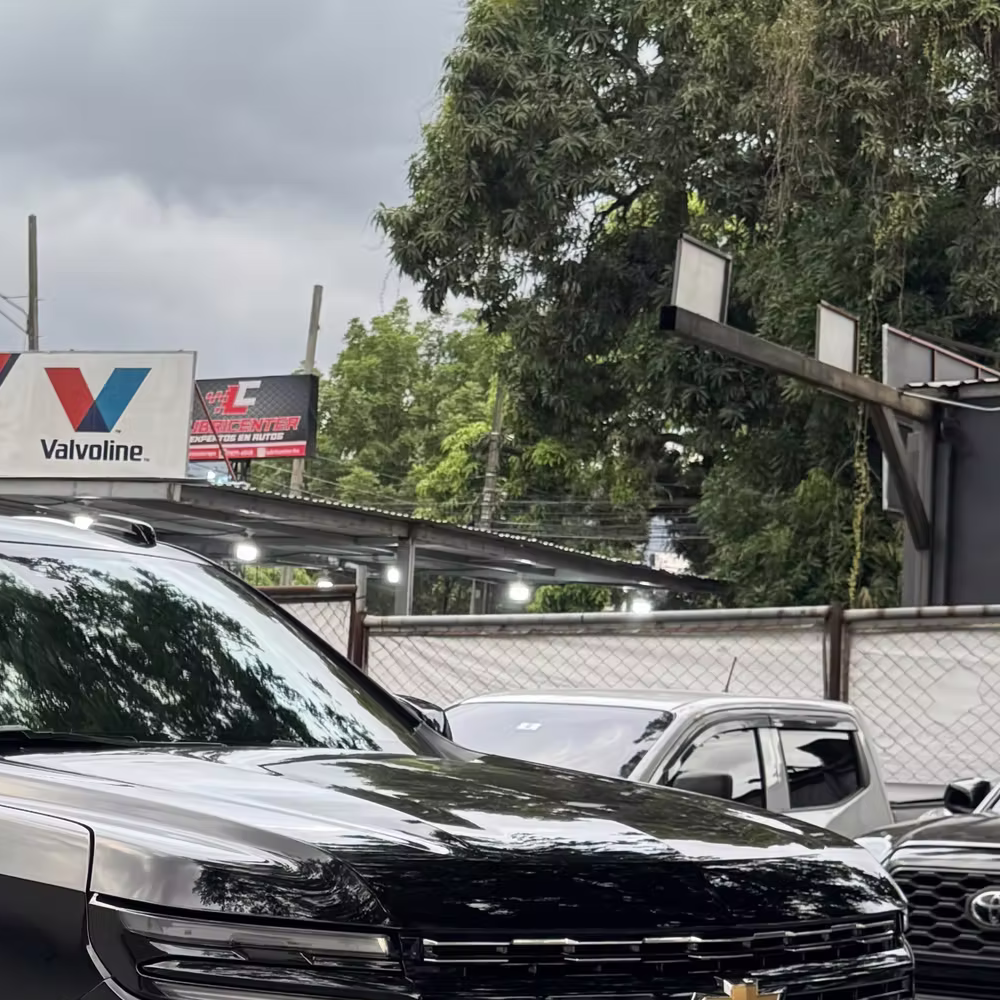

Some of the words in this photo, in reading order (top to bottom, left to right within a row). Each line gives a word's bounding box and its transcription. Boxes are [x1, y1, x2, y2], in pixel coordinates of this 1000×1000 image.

[237, 433, 251, 442] EN
[252, 432, 285, 441] AUTOS
[40, 439, 143, 461] Valvoline
